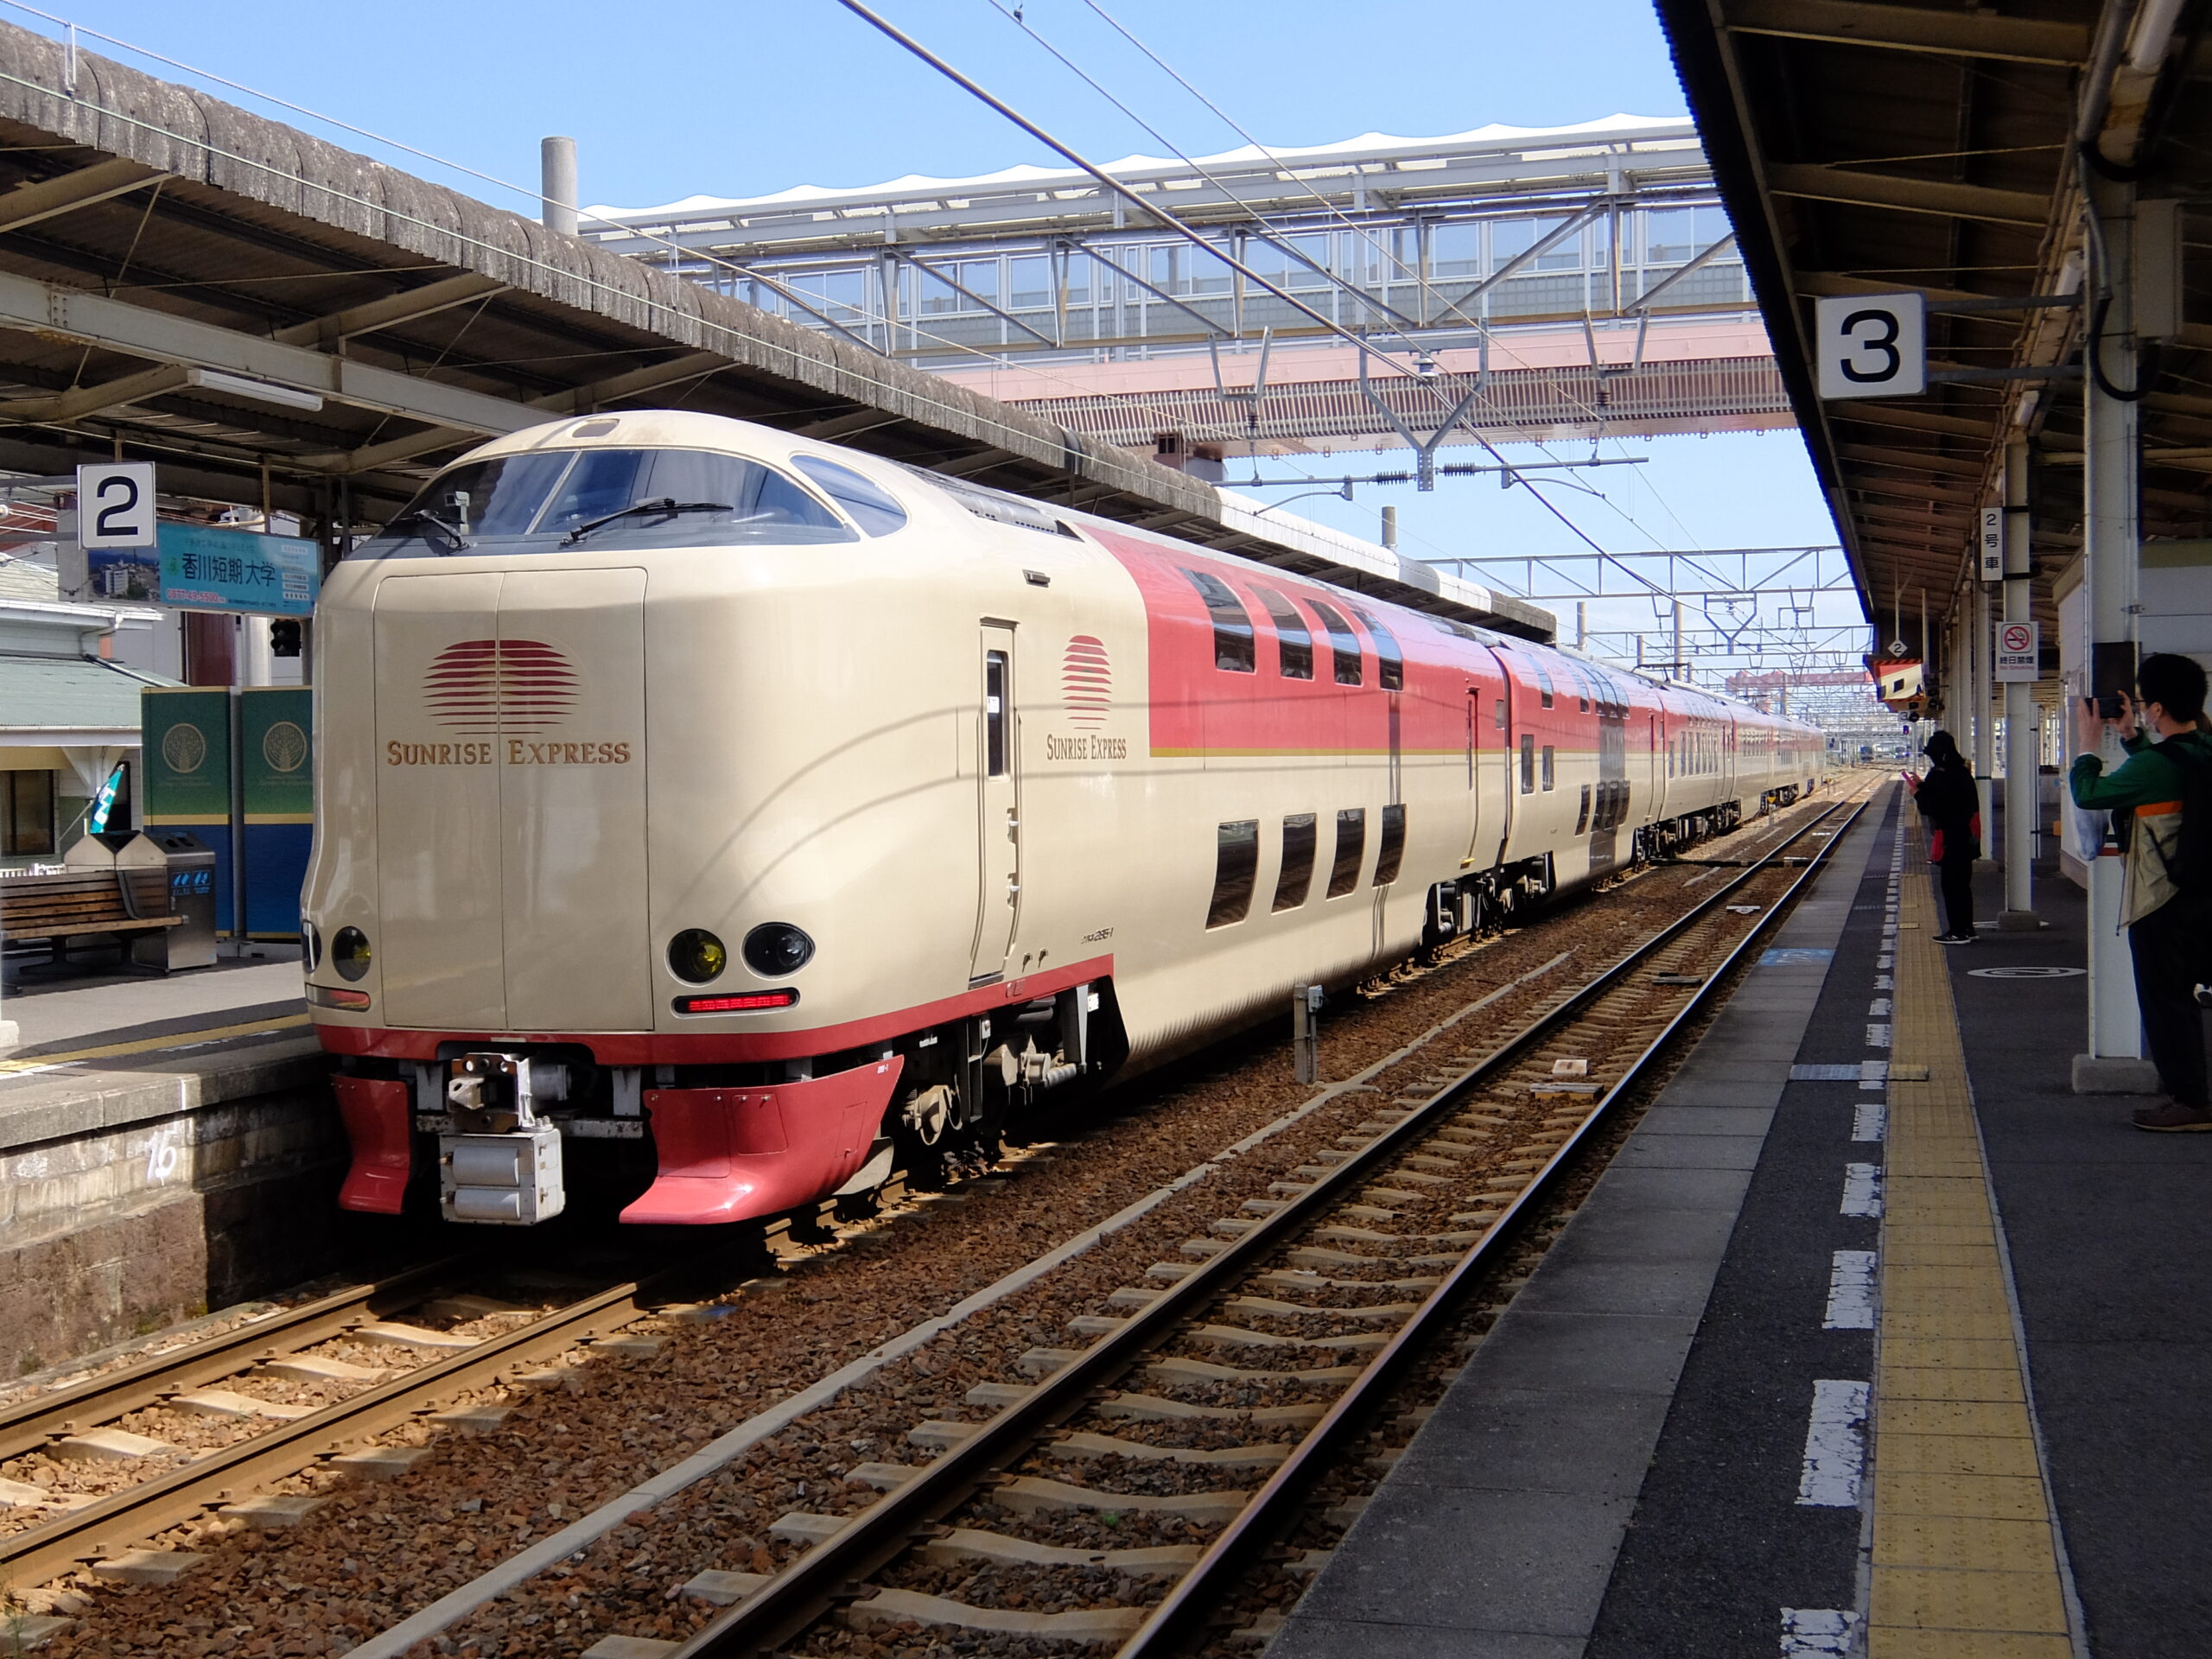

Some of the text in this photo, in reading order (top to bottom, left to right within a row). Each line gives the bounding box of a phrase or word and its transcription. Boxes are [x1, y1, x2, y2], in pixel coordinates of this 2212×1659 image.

[1840, 309, 1901, 383] 3
[96, 475, 139, 537] 2
[1985, 512, 1999, 569] 2号車
[181, 552, 276, 588] 香川短期大学
[1894, 643, 1903, 653] 2
[1999, 656, 2034, 664] 終日禁煙
[387, 739, 631, 766] SUNRISE EXPRESS
[1046, 734, 1127, 760] SUNRISE EXPRESS
